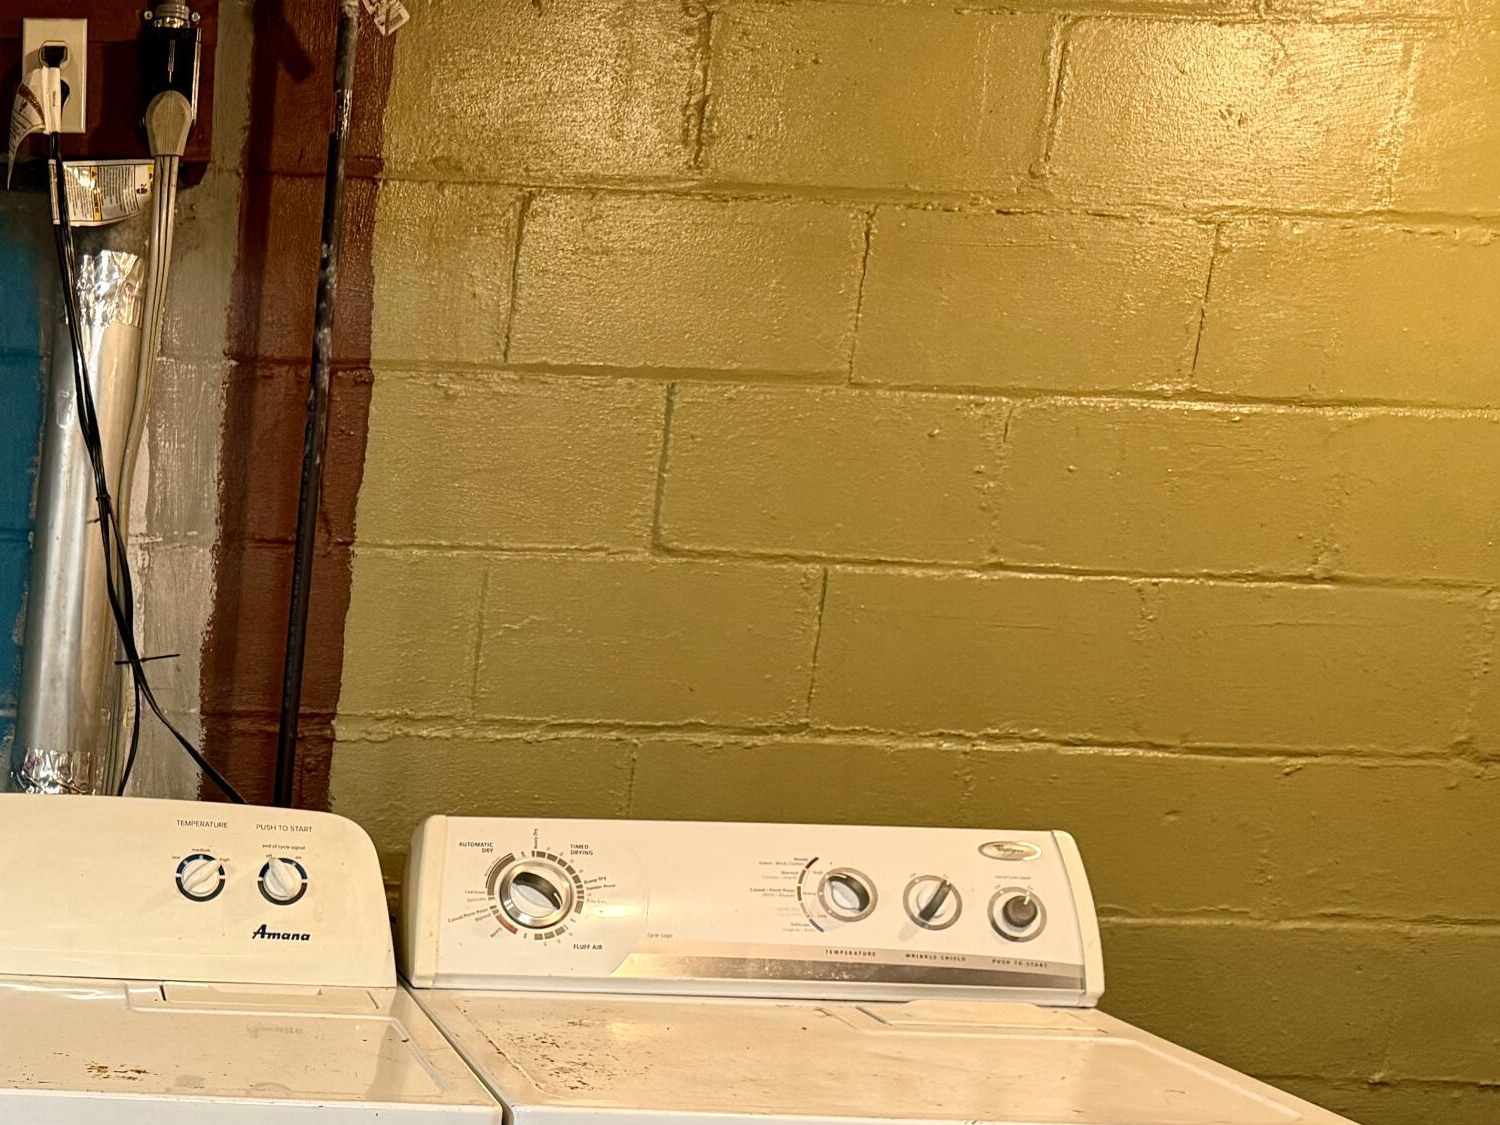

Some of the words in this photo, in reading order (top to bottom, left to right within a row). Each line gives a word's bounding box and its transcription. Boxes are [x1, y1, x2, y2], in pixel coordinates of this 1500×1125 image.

[176, 819, 228, 829] TEMPERATURE
[251, 924, 311, 941] Amana
[825, 949, 877, 957] TEMPERATURE
